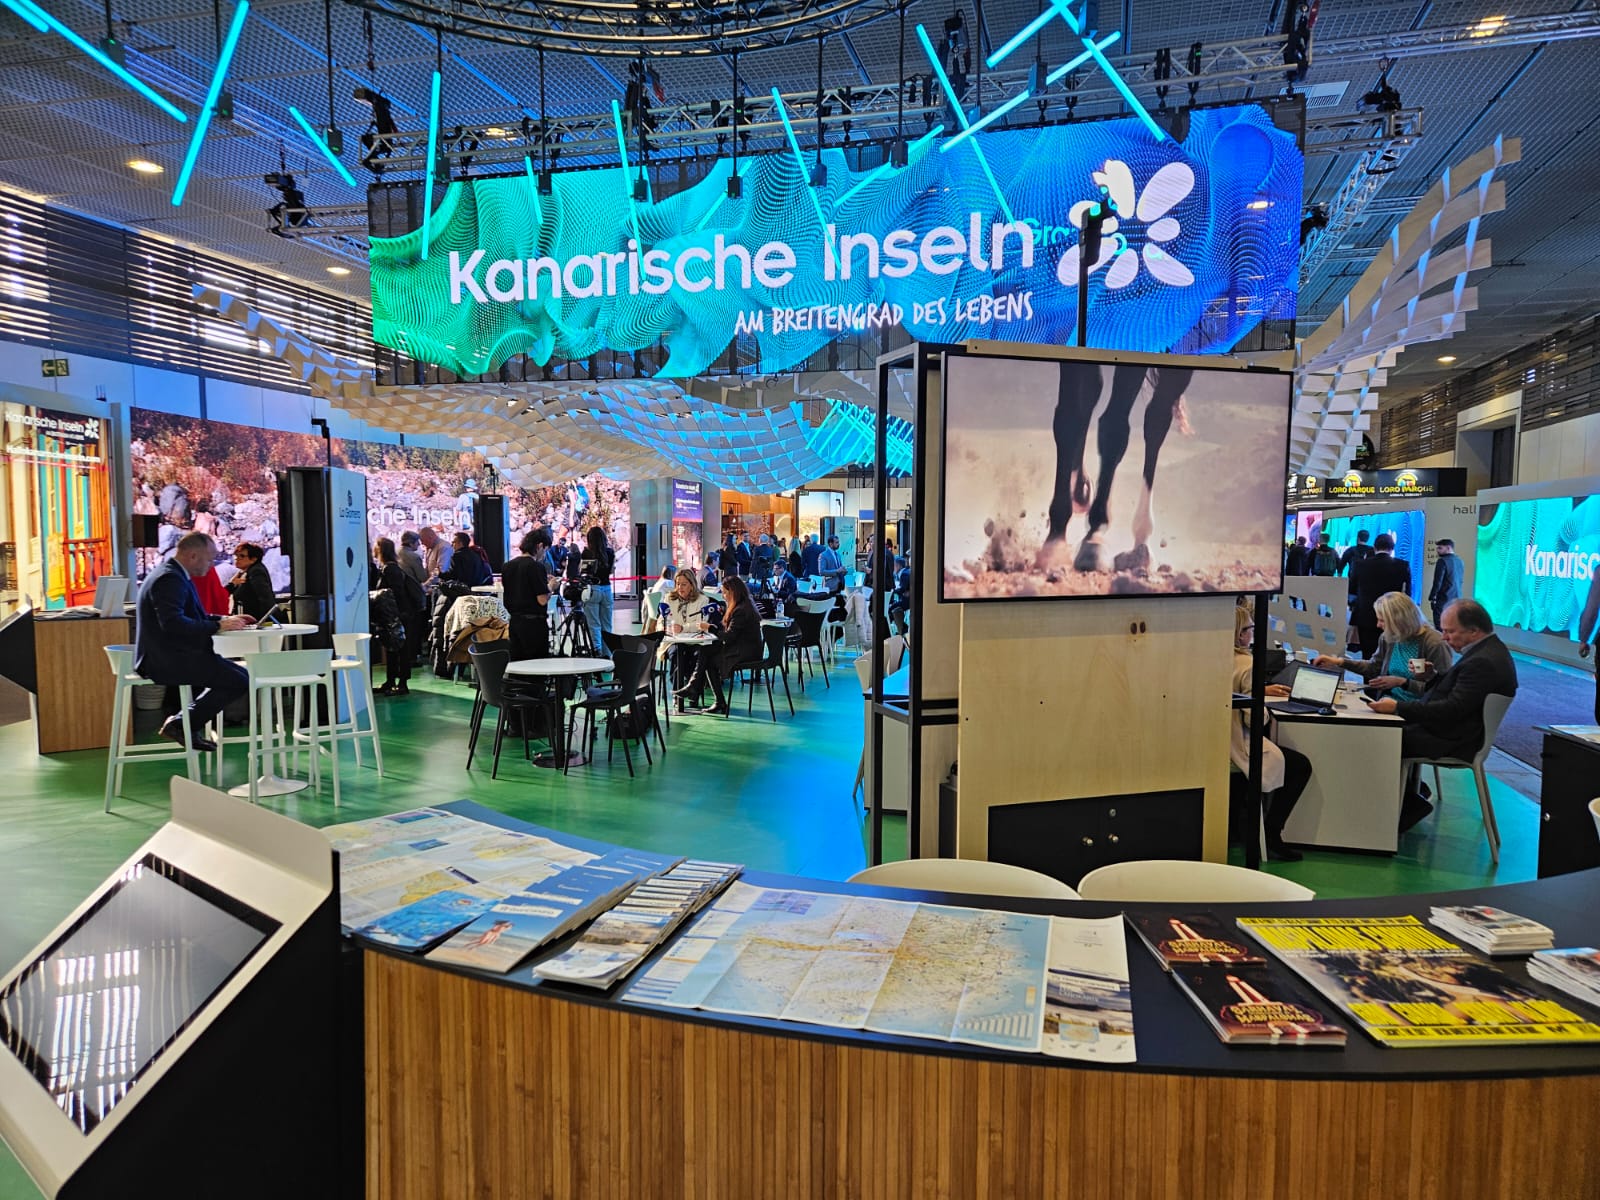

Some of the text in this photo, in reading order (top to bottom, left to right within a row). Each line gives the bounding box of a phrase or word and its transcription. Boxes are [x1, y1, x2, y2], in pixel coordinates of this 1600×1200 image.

[449, 212, 1034, 304] Kanarische Inseln
[735, 291, 1034, 335] AM BREITENGRAD DES LEBENS
[1402, 485, 1433, 493] PARQUE
[367, 504, 471, 526] che Inseln
